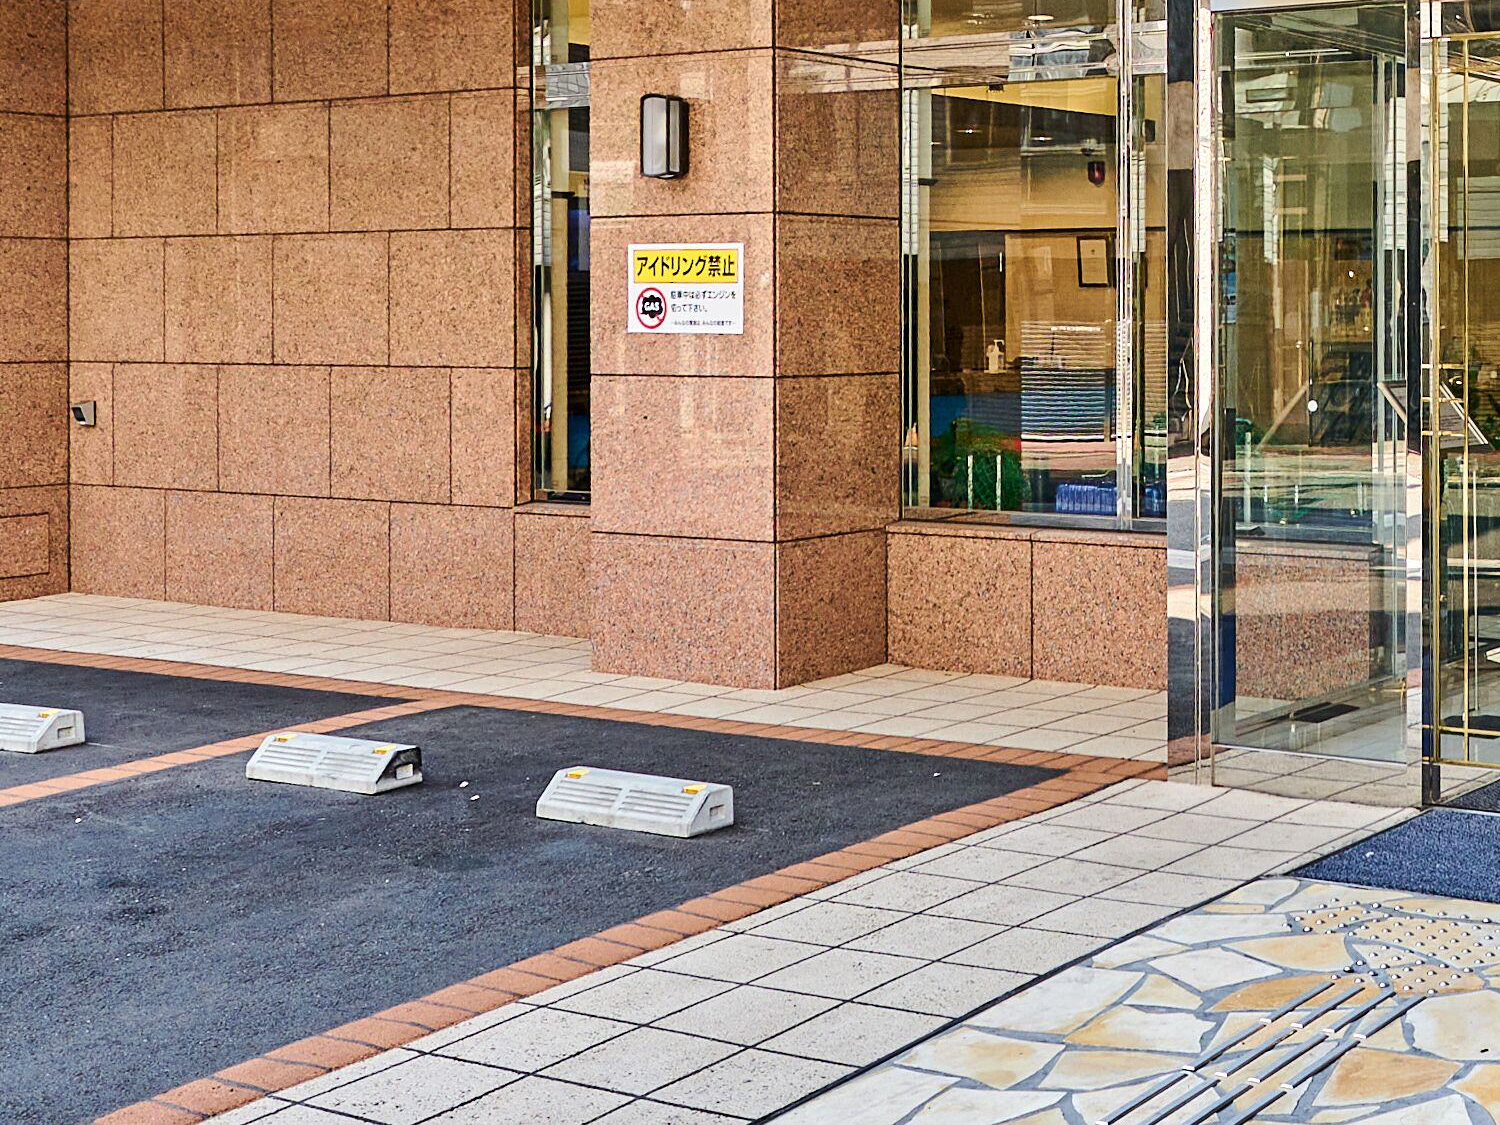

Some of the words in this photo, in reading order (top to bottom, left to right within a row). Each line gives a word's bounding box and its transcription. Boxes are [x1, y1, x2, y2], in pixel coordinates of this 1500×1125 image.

[636, 255, 736, 277] アイドリング禁止
[643, 301, 660, 313] GAS
